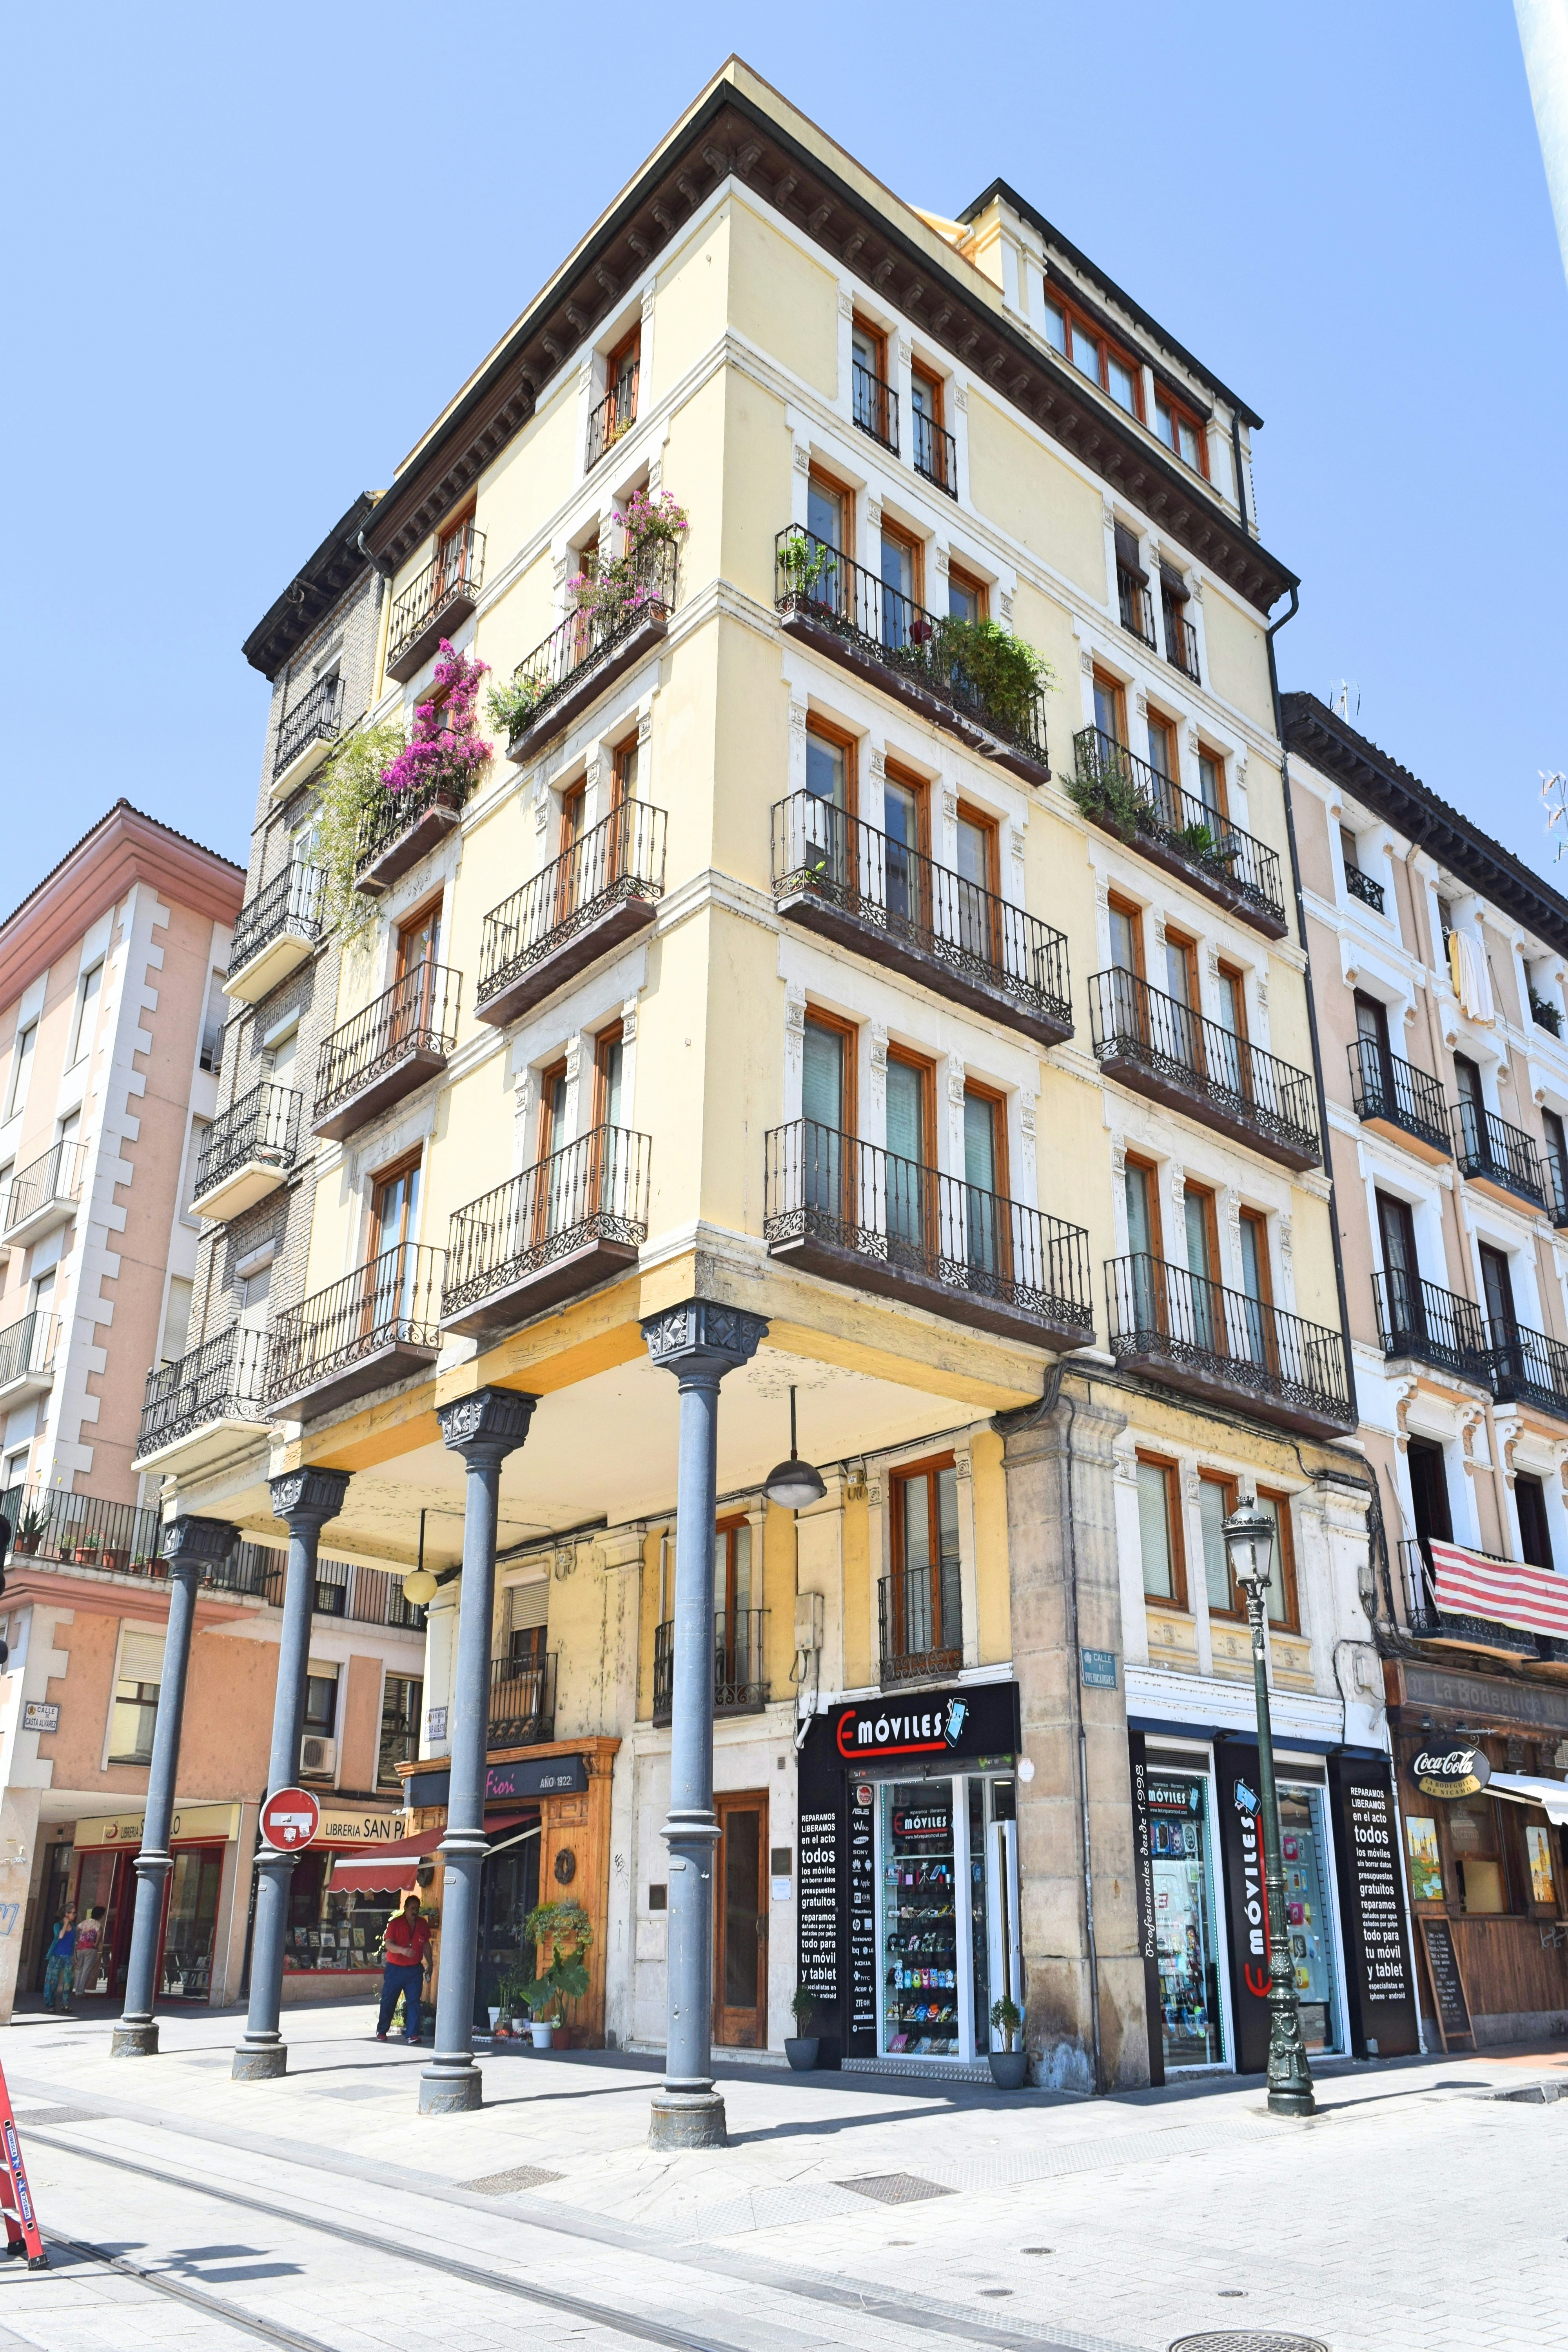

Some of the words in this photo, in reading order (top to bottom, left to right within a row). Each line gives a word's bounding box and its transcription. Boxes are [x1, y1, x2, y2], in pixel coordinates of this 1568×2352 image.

[1094, 1653, 1112, 1663] CALLE
[1085, 1672, 1114, 1685] PREDICADORES
[1433, 1674, 1452, 1700] La
[1414, 1750, 1476, 1775] Coca-Cola
[540, 1776, 554, 1788] AÑO
[1436, 1779, 1473, 1789] BODEGUITA
[1351, 1787, 1384, 1798] REPARAMOS
[1441, 1787, 1471, 1795] NICAMO
[1352, 1799, 1385, 1810] LIBERAMOS
[802, 1813, 835, 1822] REPARAMOS
[1353, 1813, 1361, 1821] en
[1364, 1811, 1370, 1821] el
[1372, 1813, 1387, 1823] acto
[121, 1826, 138, 1838] LIBRERIA
[326, 1823, 361, 1837] LIBRERIA
[364, 1819, 390, 1838] SAN
[802, 1823, 835, 1833] LIBERAMOS
[812, 1835, 818, 1844] el
[820, 1834, 835, 1843] acto
[1139, 1818, 1148, 1856] desde
[1354, 1825, 1388, 1844] todos
[802, 1847, 835, 1863] todos
[1356, 1847, 1366, 1857] los
[1368, 1848, 1390, 1858] móviles
[813, 1866, 835, 1875] móviles
[1359, 1872, 1393, 1881] presupuestos
[860, 1879, 870, 1888] Apple
[802, 1887, 835, 1895] presupuestos
[1360, 1883, 1394, 1897] gratuitos
[802, 1896, 835, 1909] gratuitos
[1142, 1860, 1155, 1957] Profesionales
[1361, 1901, 1396, 1911] reparamos
[802, 1914, 835, 1923] reparamos
[1363, 1928, 1381, 1940] todo
[1383, 1932, 1399, 1943] para
[802, 1938, 818, 1948] todo
[820, 1940, 835, 1950] para
[852, 1946, 859, 1956] bq
[1365, 1946, 1374, 1958] tu
[1377, 1945, 1401, 1958] móvil
[802, 1953, 809, 1963] tu
[813, 1952, 835, 1963] móvil
[802, 1970, 807, 1982] y
[810, 1967, 836, 1980] tablet
[1367, 1966, 1372, 1981] y
[1376, 1962, 1403, 1976] tablet
[1369, 1982, 1397, 1991] especialistas
[1370, 1993, 1385, 2001] iphone
[8, 2130, 16, 2156] TUBESCA
[22, 2193, 30, 2218] TUBESCA
